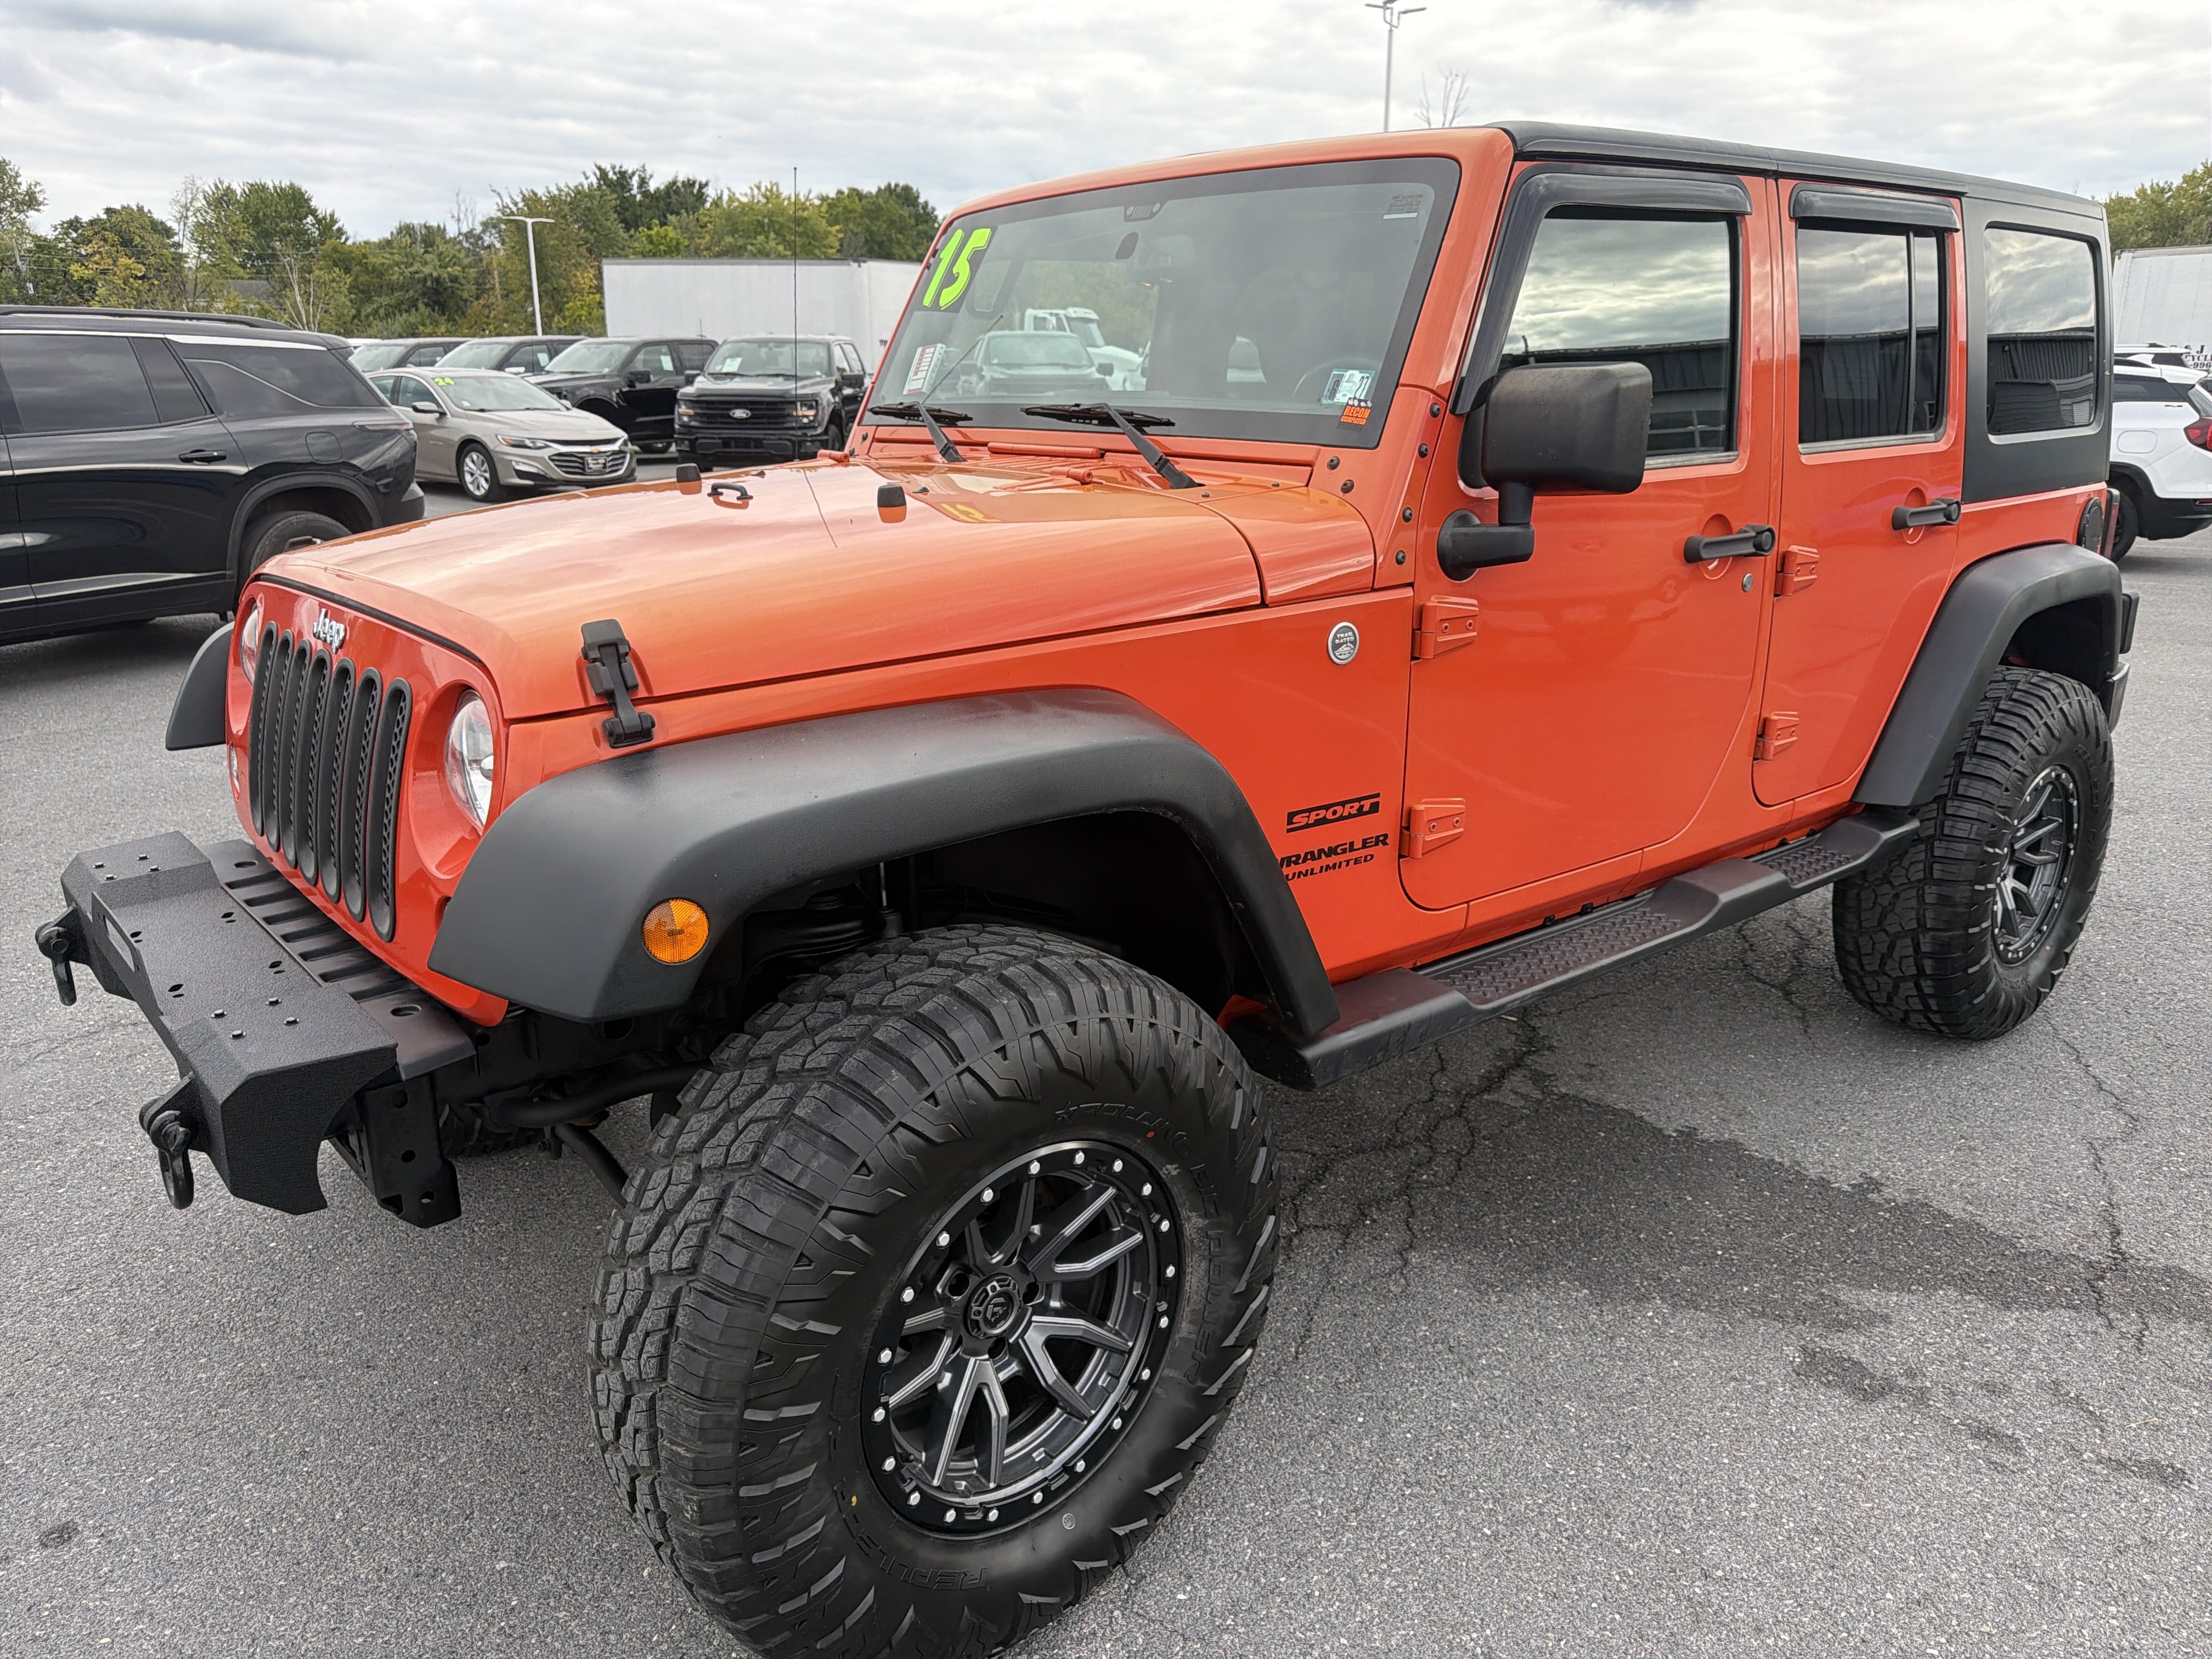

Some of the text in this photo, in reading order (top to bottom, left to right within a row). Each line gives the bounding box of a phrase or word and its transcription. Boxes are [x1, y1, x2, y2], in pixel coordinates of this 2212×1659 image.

[923, 228, 992, 310] 15
[434, 377, 454, 386] 24
[1353, 375, 1370, 398] 27
[1343, 405, 1371, 419] RECON
[313, 608, 346, 654] Jeep
[1335, 636, 1355, 645] RATED
[1286, 799, 1379, 830] SPORT
[1284, 854, 1374, 882] UNLIMITED
